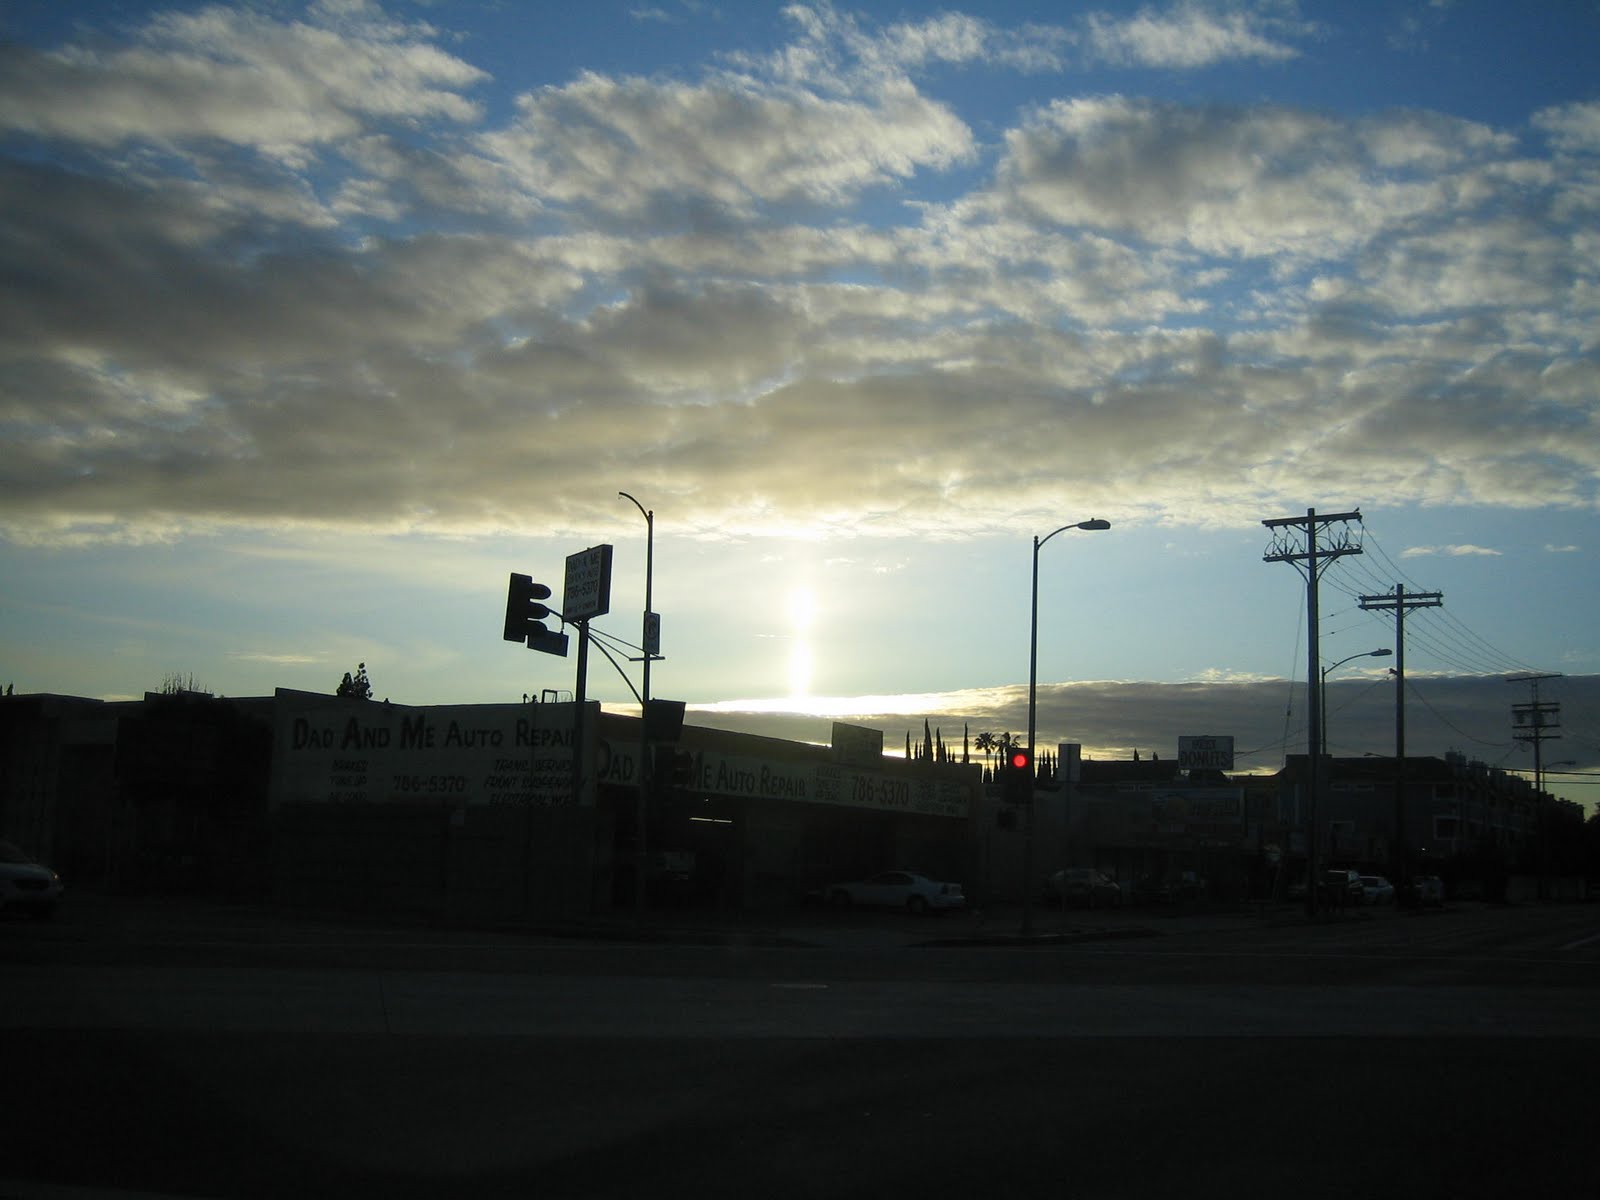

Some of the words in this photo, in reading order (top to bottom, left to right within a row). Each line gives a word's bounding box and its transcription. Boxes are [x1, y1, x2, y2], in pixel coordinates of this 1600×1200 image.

[400, 714, 436, 750] ME
[445, 719, 504, 748] AUTO
[393, 775, 466, 793] 786-5370
[716, 759, 755, 794] AUTO
[851, 775, 910, 806] 786-5370
